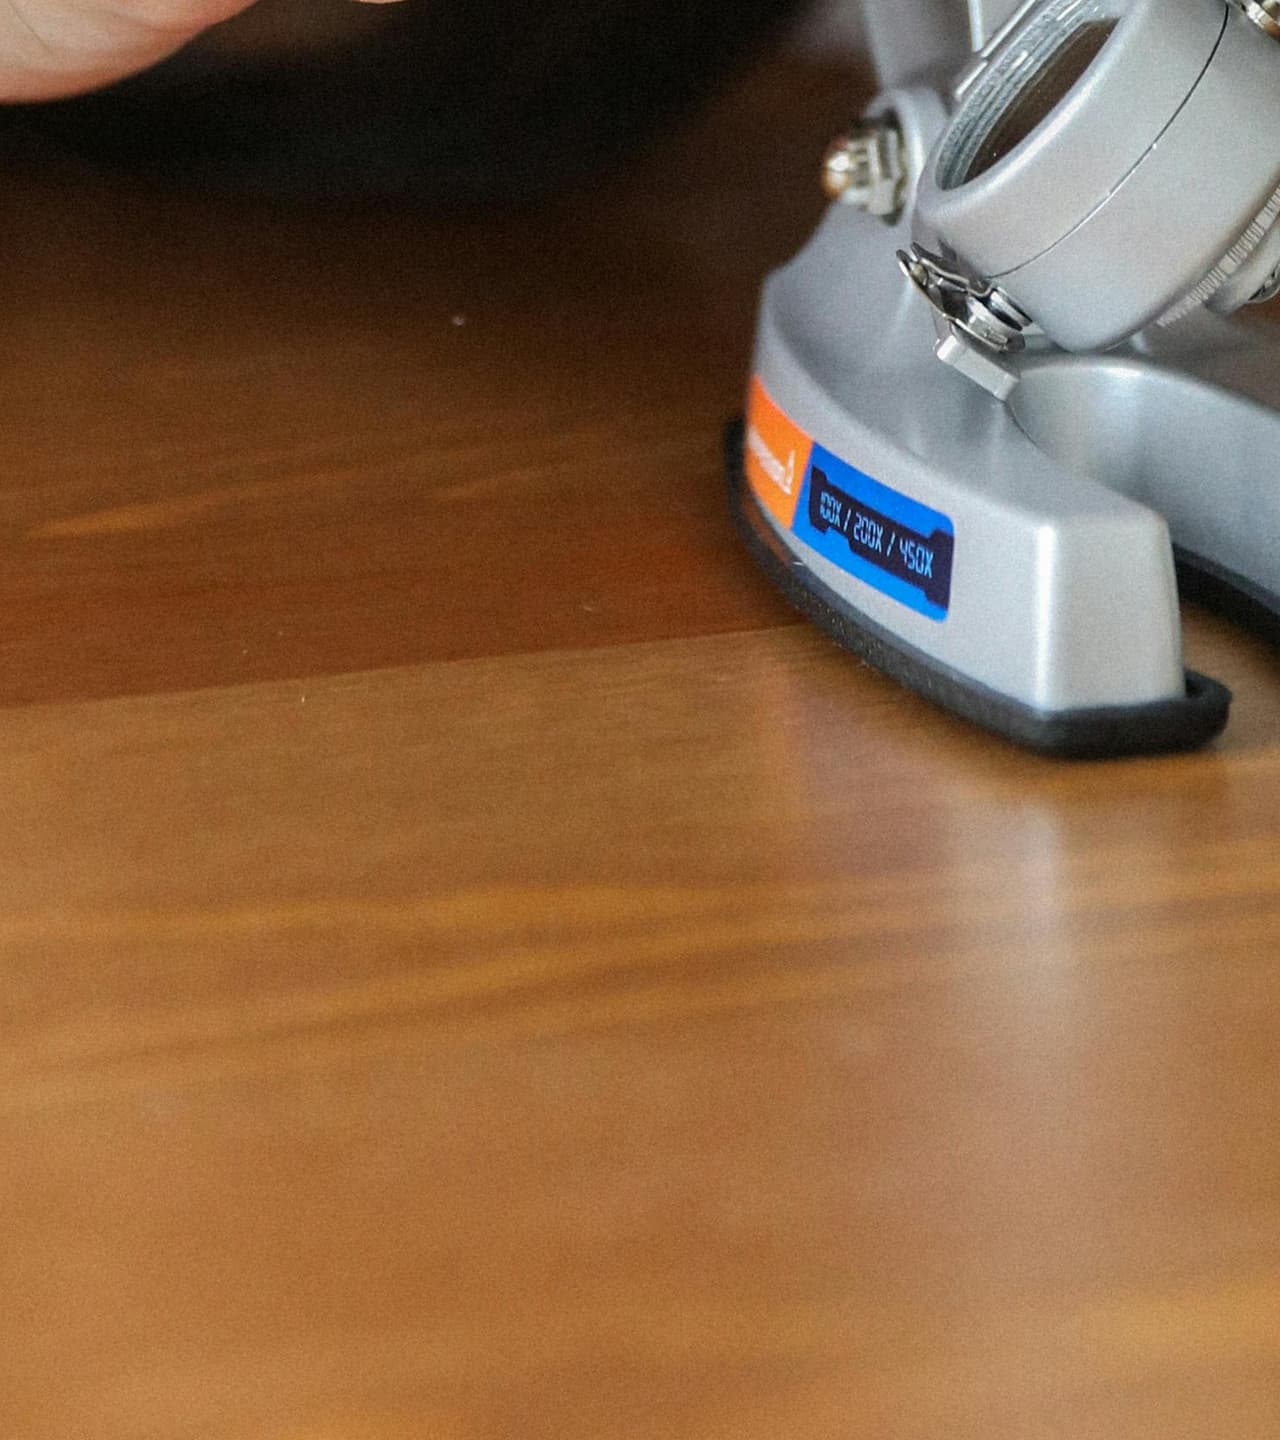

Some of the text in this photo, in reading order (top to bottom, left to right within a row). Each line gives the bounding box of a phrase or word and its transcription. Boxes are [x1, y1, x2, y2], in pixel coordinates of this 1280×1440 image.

[843, 508, 852, 532] /
[853, 511, 884, 553] 200X
[886, 531, 896, 557] /
[899, 538, 934, 579] 450X
